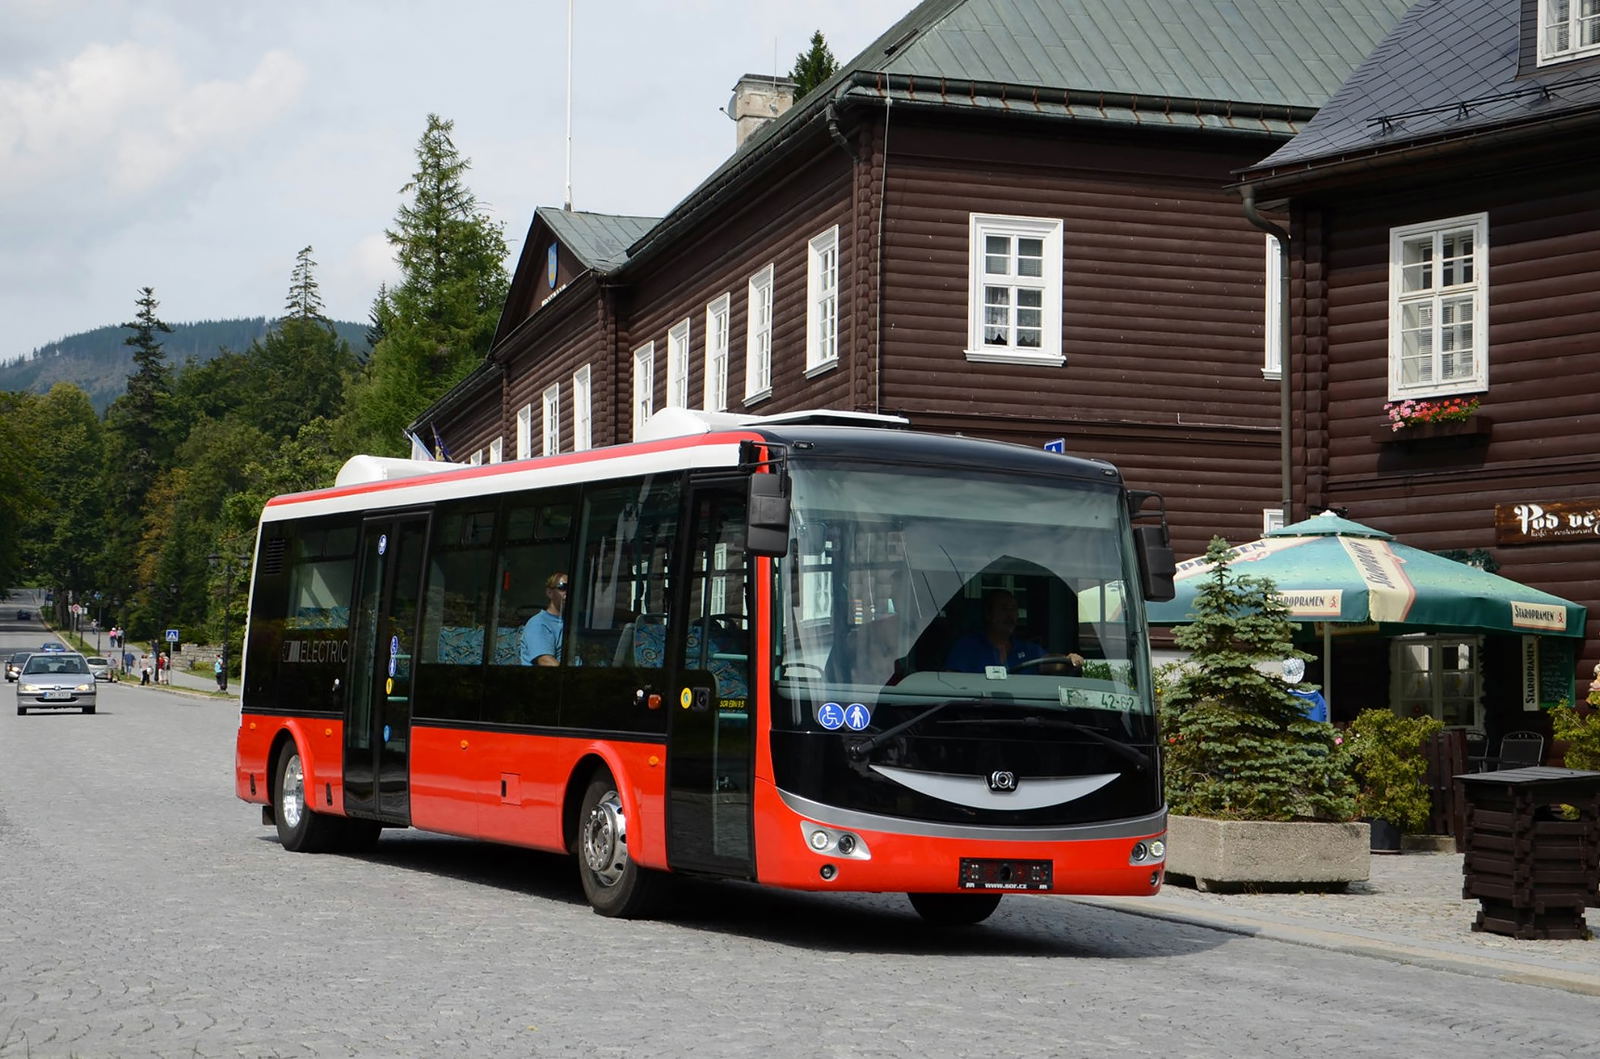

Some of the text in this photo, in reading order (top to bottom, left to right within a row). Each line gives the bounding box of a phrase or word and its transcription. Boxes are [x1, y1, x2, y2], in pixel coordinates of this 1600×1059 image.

[1513, 504, 1559, 535] Pod
[1349, 541, 1395, 589] STAROPRAMEN
[1514, 605, 1555, 621] STAROPRAMEN
[300, 640, 348, 663] ELECTRIC
[1525, 643, 1536, 704] STAROPRAMEN
